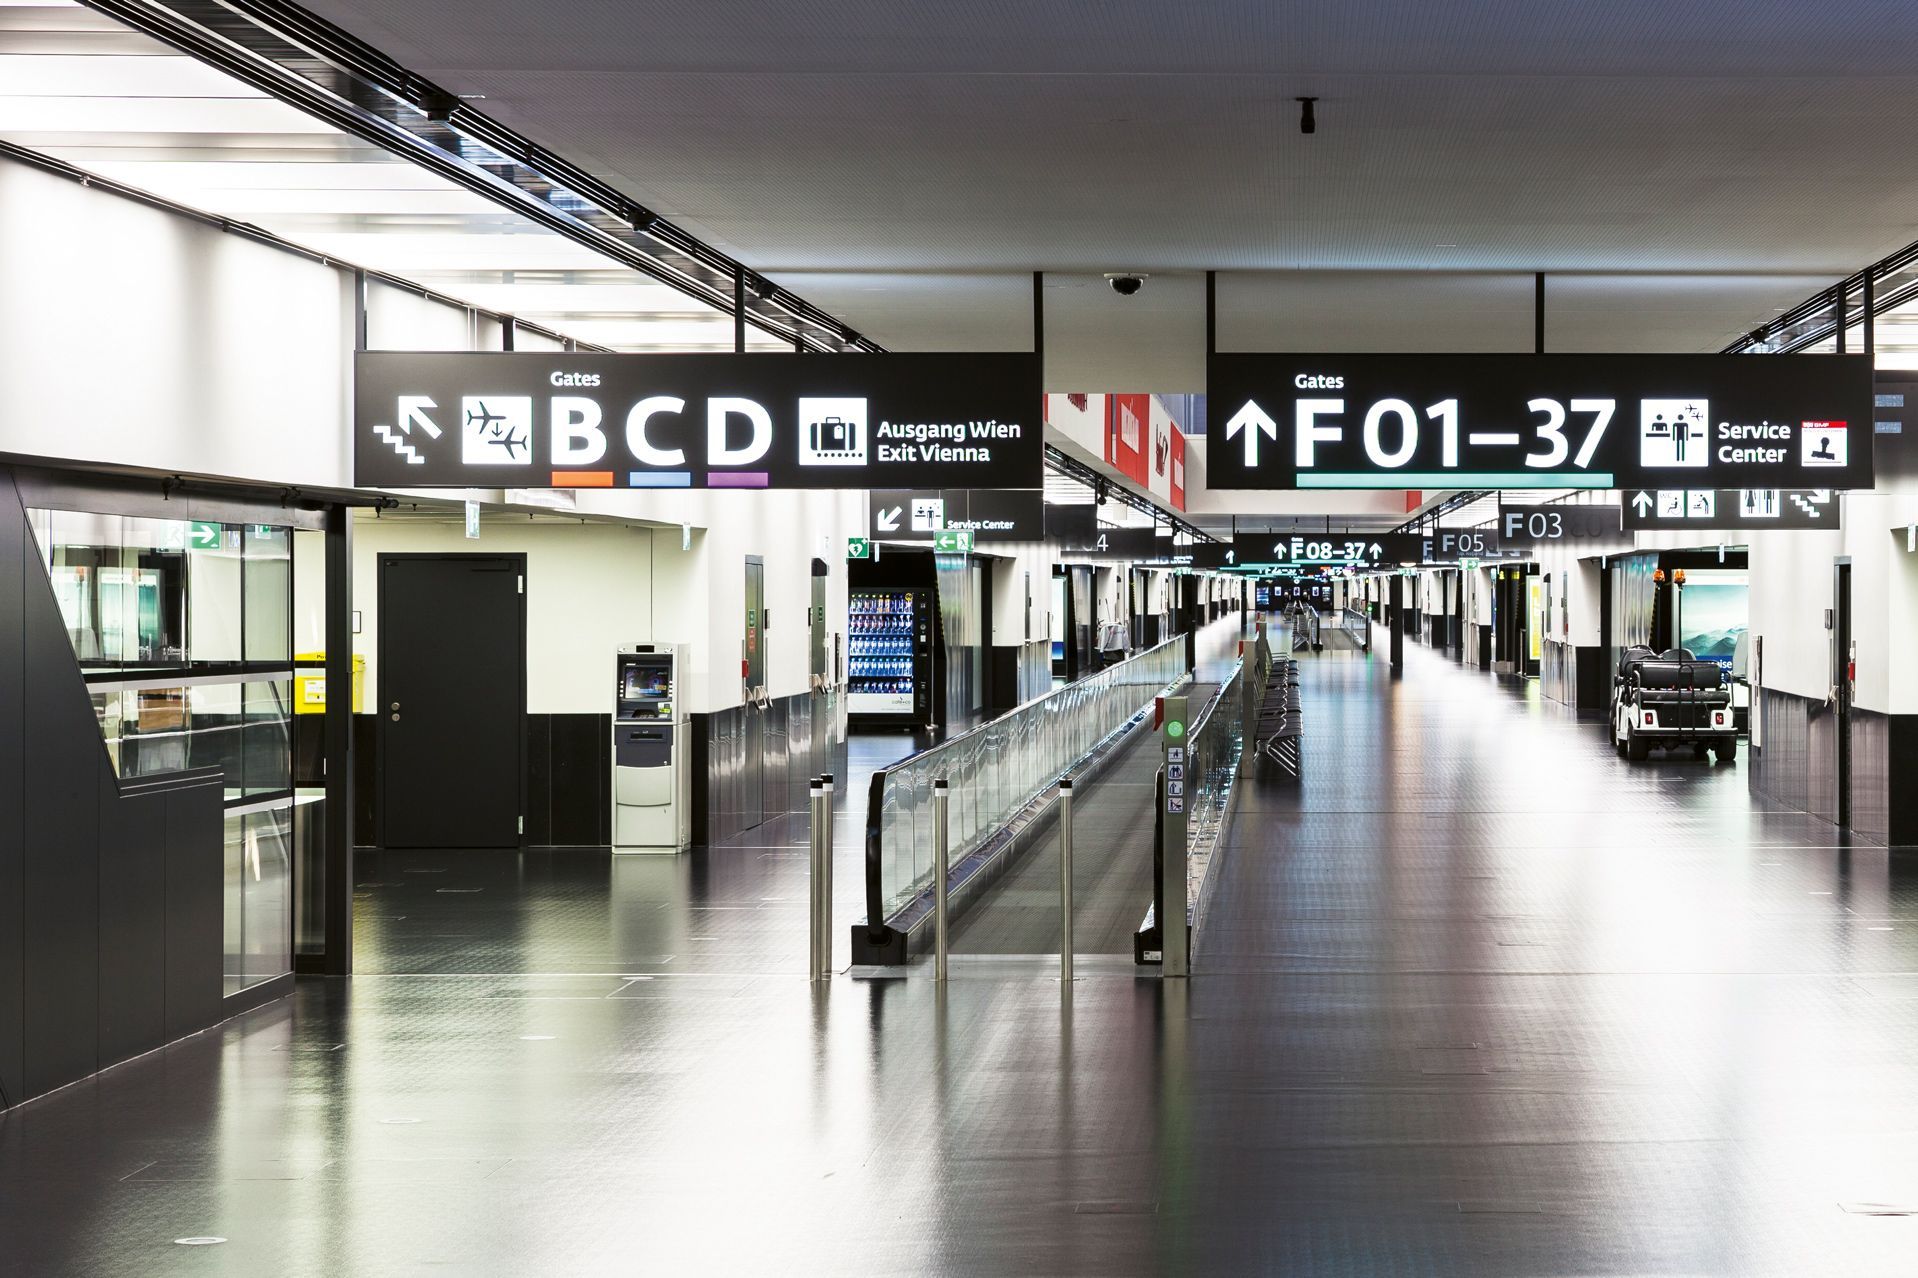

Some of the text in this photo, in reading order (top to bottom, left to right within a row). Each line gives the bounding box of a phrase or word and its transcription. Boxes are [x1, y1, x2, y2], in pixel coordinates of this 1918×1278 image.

[550, 371, 601, 387] Gates
[1294, 374, 1345, 389] Gates
[550, 396, 773, 467] B C D
[877, 420, 1021, 443] Ausgang Wien
[1295, 399, 1345, 467] F
[1718, 421, 1792, 440] Service
[877, 444, 990, 462] Exit Vienna
[1718, 446, 1787, 463] Center
[947, 519, 1015, 531] Service Center
[1506, 513, 1524, 538] F
[1528, 513, 1563, 538] 03
[1290, 542, 1304, 560] F
[1442, 534, 1484, 552] F 05
